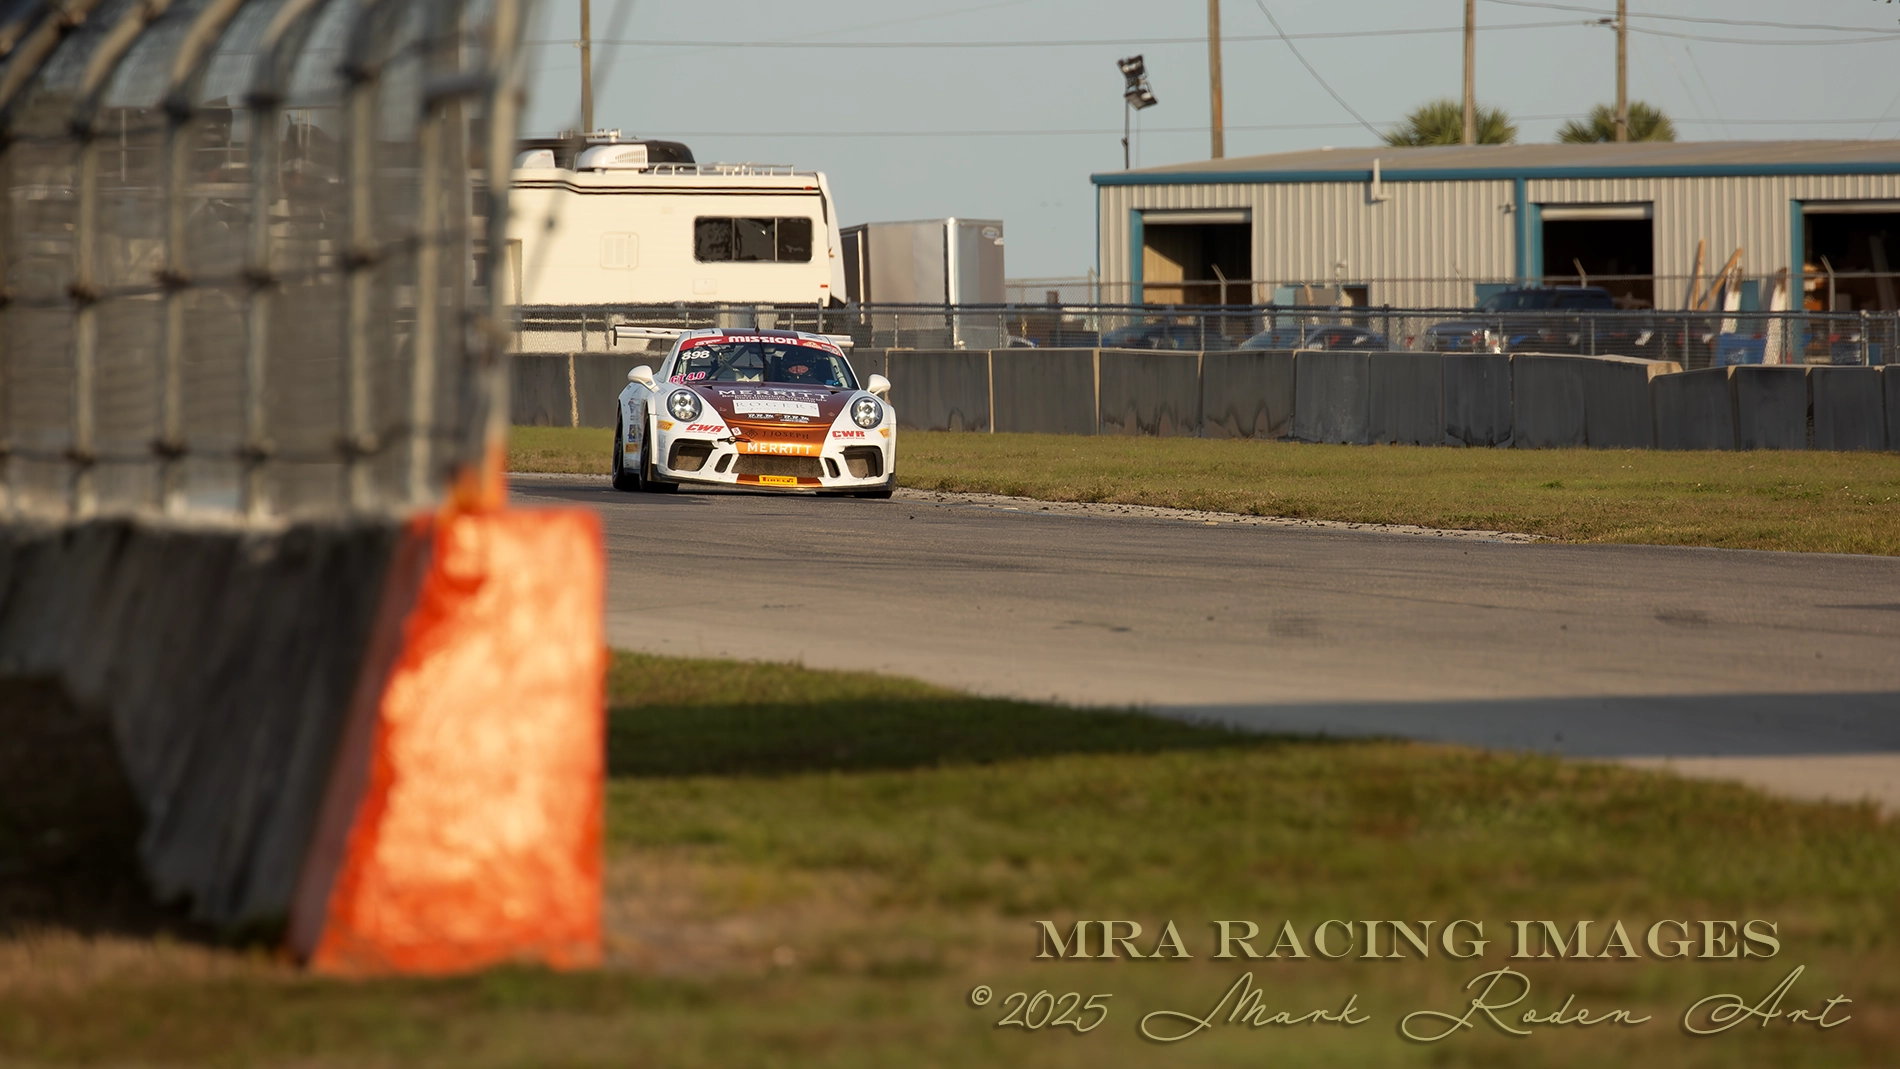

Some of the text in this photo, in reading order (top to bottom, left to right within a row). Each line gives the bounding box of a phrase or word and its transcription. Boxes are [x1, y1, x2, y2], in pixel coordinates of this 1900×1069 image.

[681, 350, 710, 360] 898
[670, 374, 686, 384] GT
[718, 390, 829, 399] MERRITT
[736, 402, 817, 410] ROGERS
[686, 424, 724, 432] CWR
[747, 442, 812, 454] MERRITT
